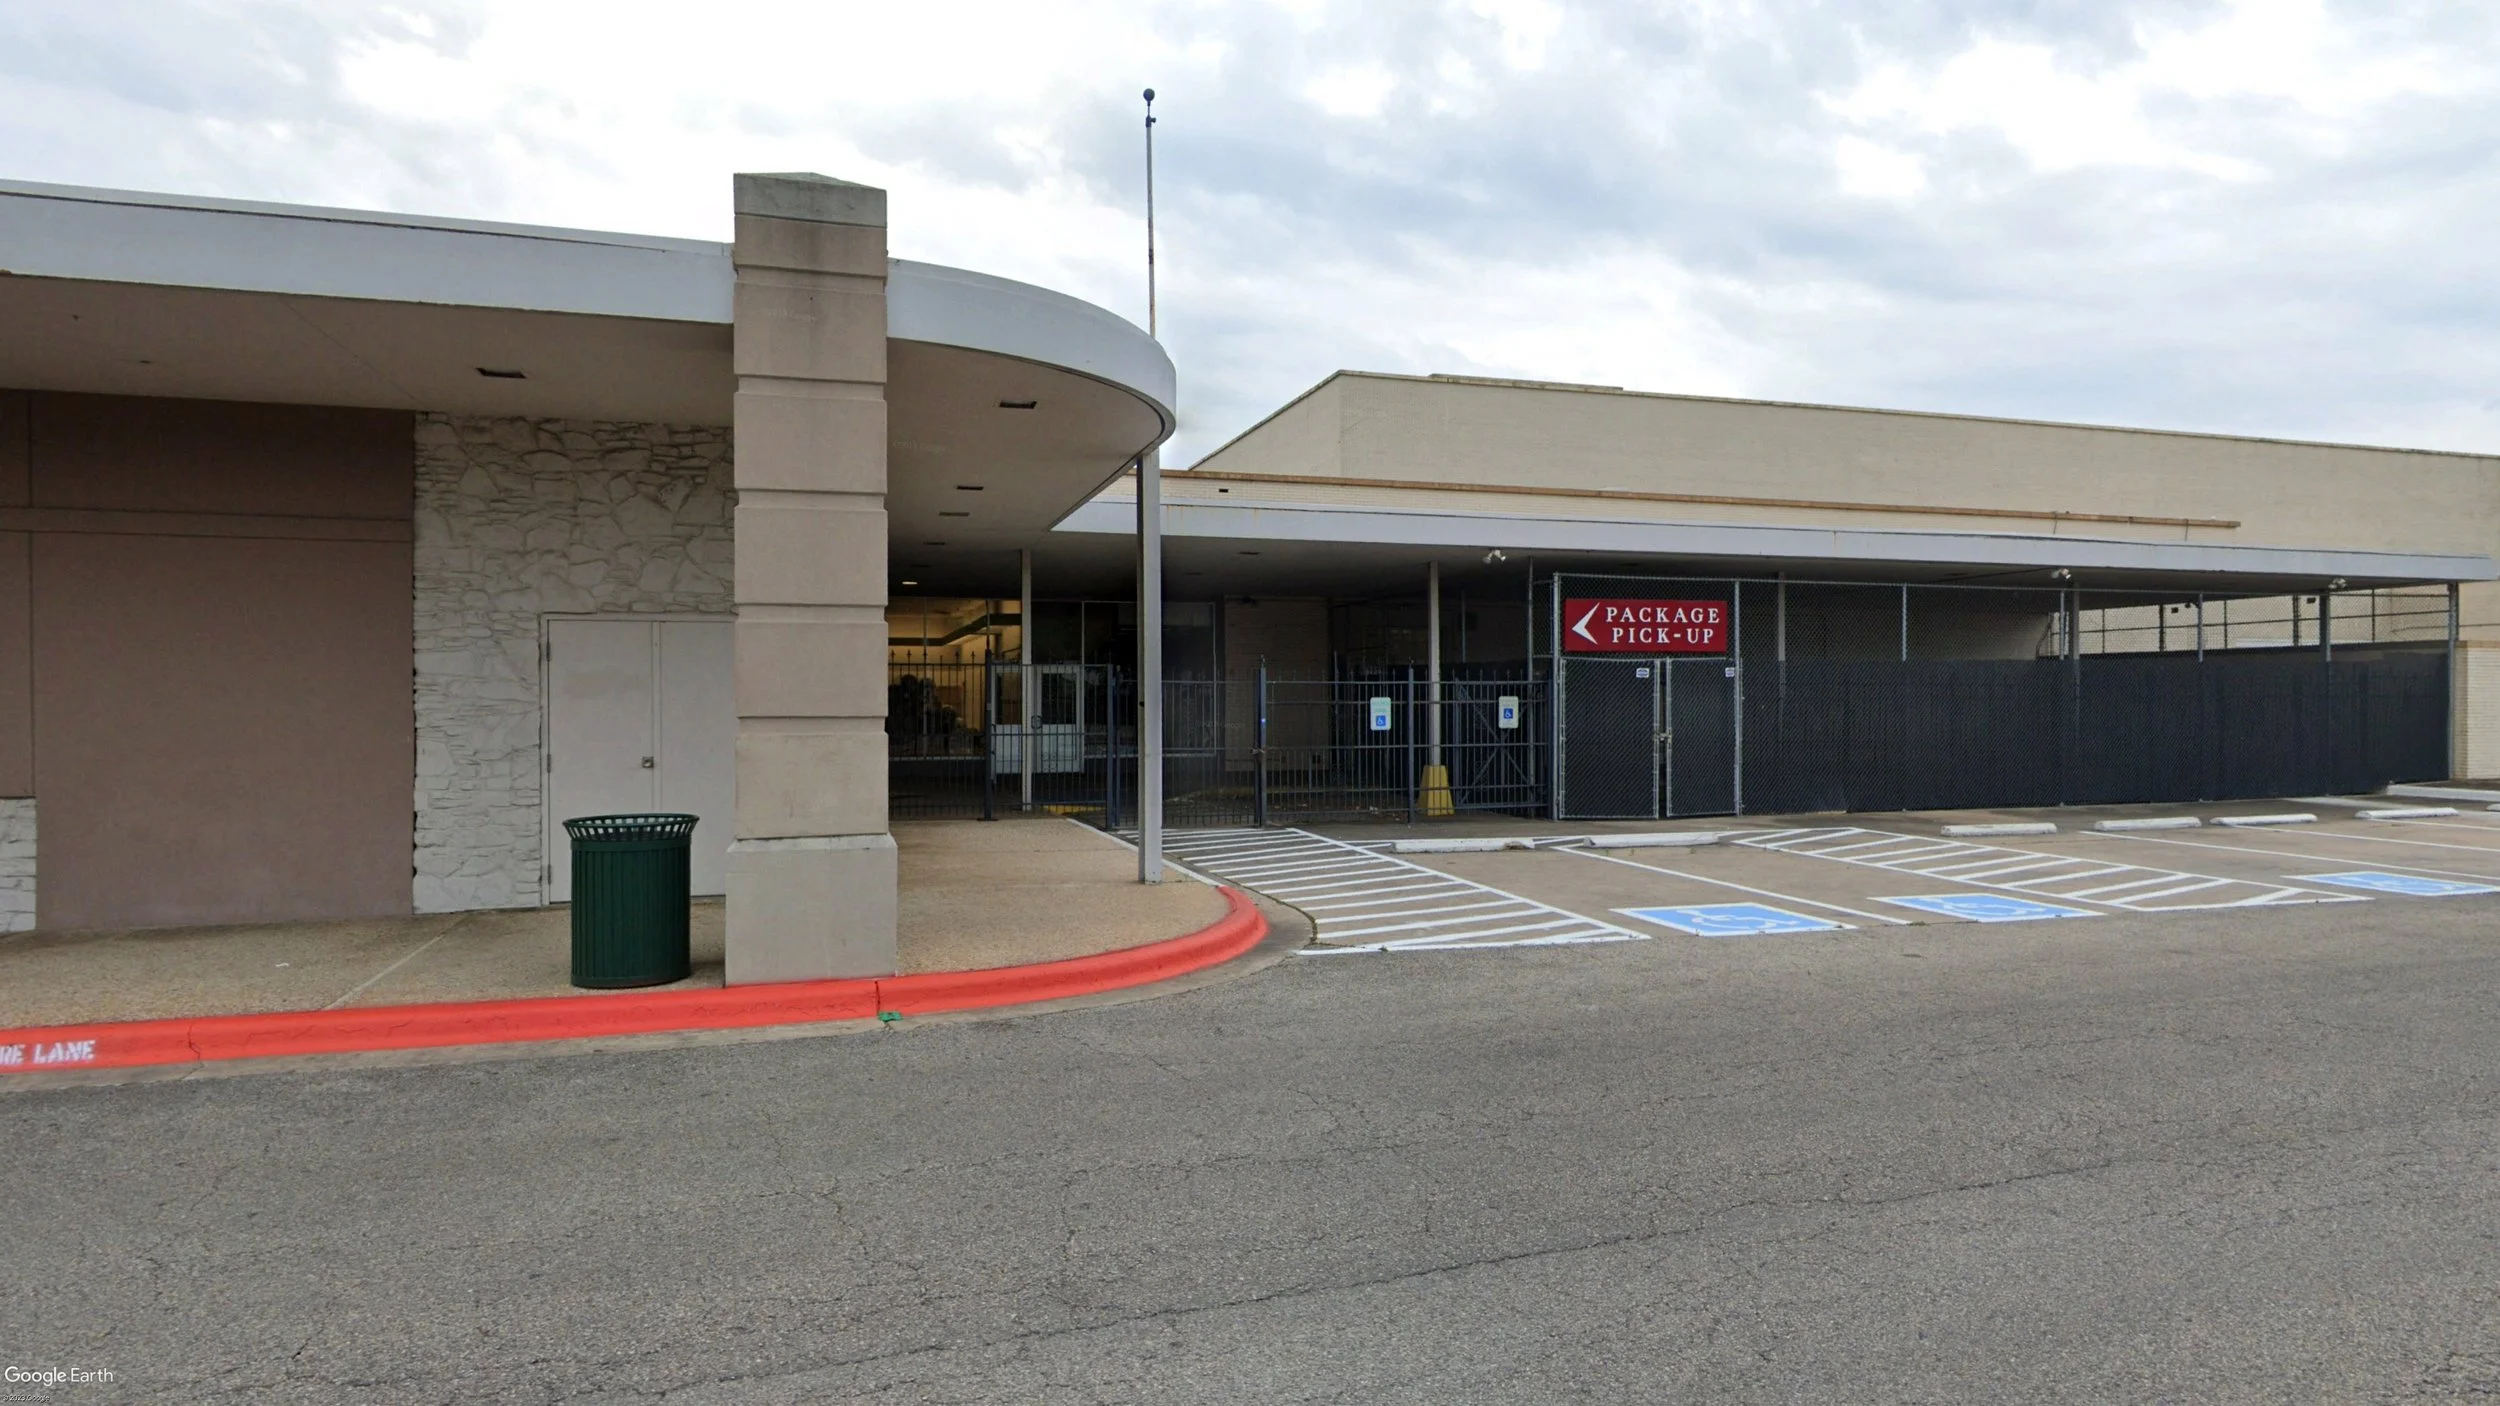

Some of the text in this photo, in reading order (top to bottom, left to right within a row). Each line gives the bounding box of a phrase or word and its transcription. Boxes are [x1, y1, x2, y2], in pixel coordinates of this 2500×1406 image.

[1605, 606, 1720, 624] PACKAGE
[1612, 627, 1714, 644] PICK-UP
[33, 1039, 97, 1064] LANE
